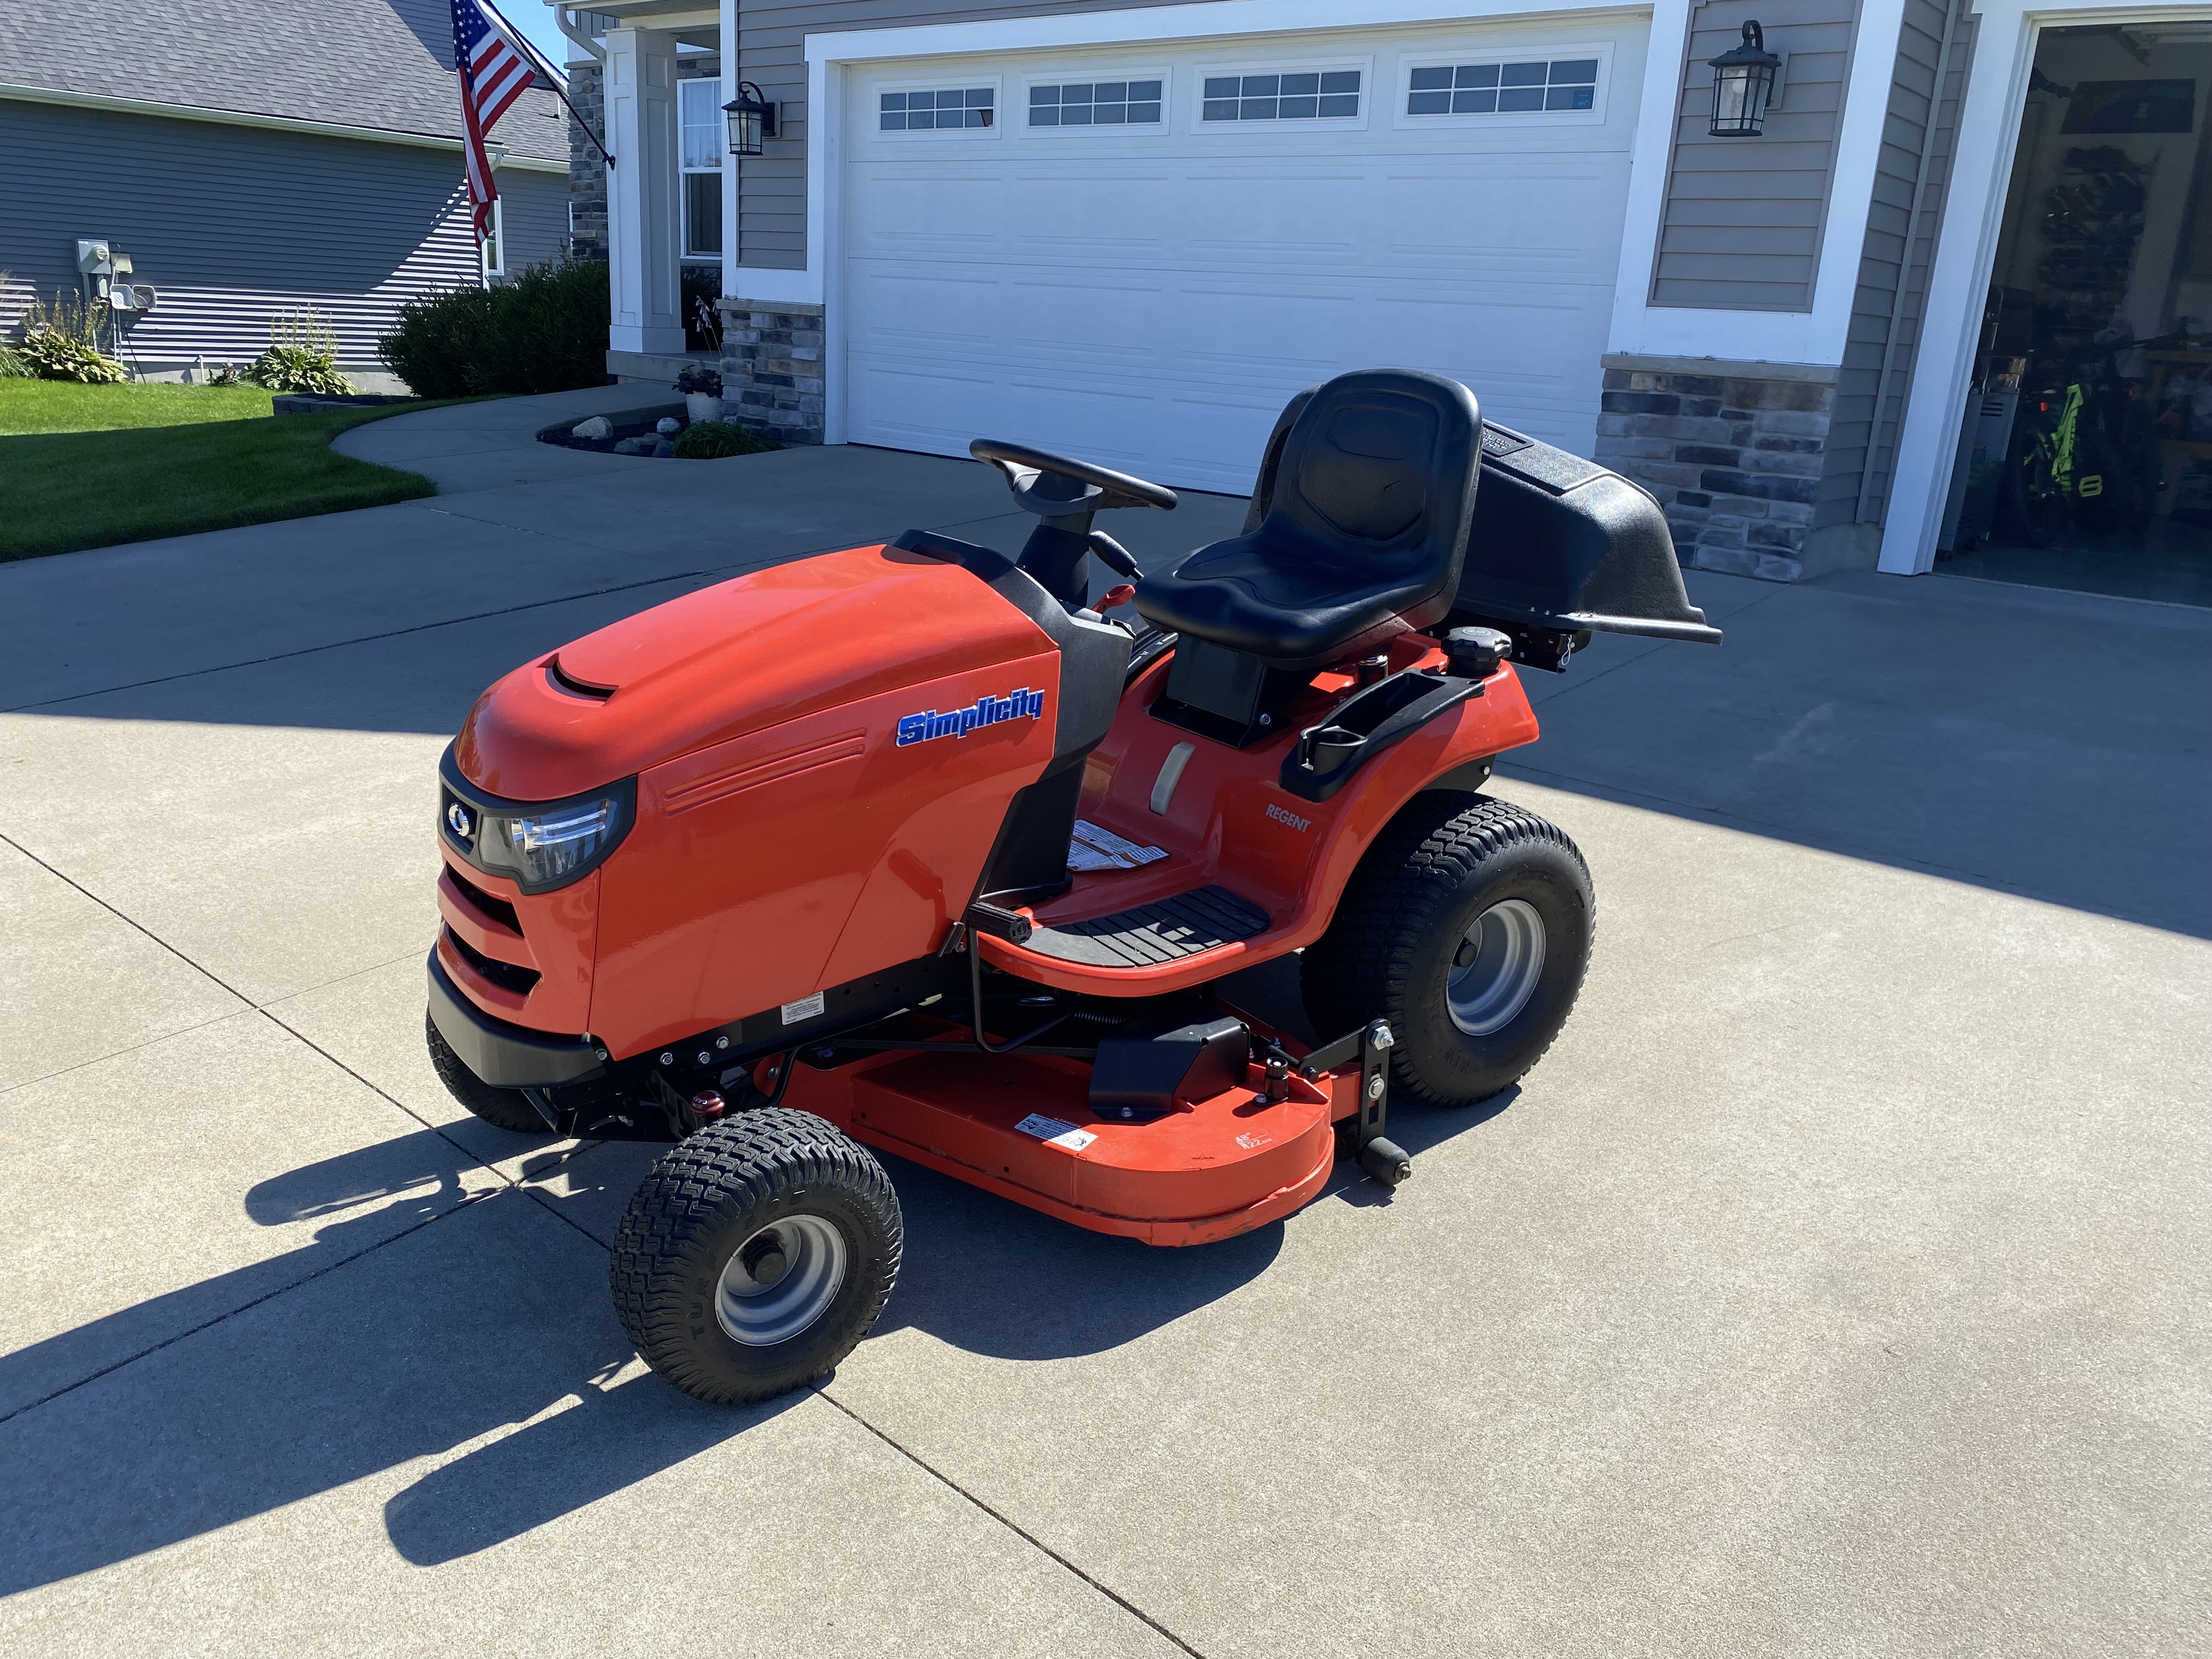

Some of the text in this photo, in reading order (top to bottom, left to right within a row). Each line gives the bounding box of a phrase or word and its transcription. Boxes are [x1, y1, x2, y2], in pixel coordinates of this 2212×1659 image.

[895, 687, 1045, 747] Simplicity
[1266, 803, 1311, 832] REGENT
[1058, 1118, 1082, 1128] DANGER
[691, 1255, 718, 1340] TURF
[831, 1257, 880, 1343] KENDA
